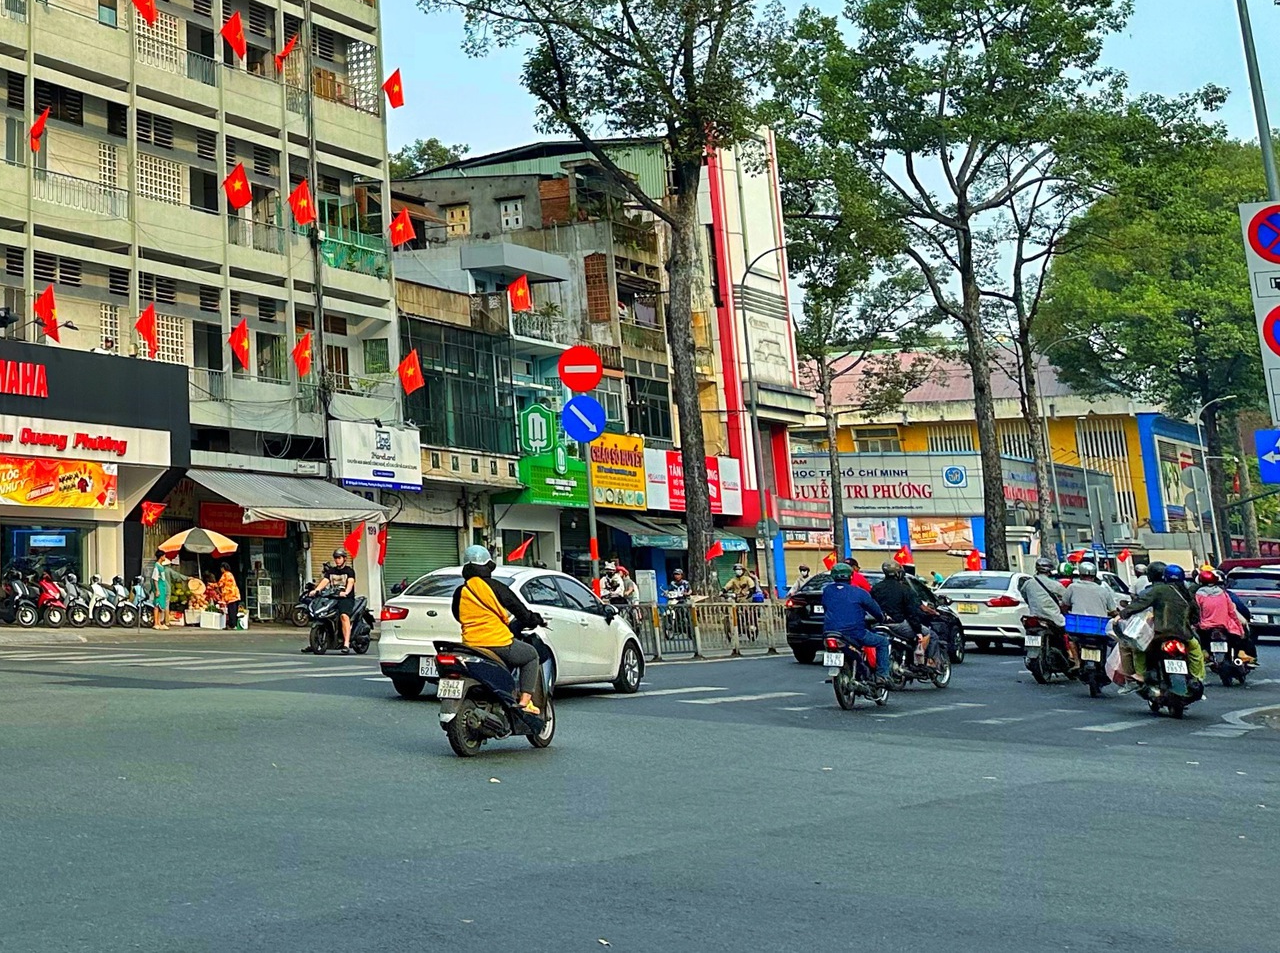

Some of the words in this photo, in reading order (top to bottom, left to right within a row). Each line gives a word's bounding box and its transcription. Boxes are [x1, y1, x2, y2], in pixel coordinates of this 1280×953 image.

[20, 427, 68, 451] Quang
[858, 468, 878, 477] CHÍ
[880, 469, 908, 477] MINH
[793, 479, 831, 499] GUYỄ
[843, 484, 869, 499] TRI
[872, 481, 933, 499] PHƯƠNG
